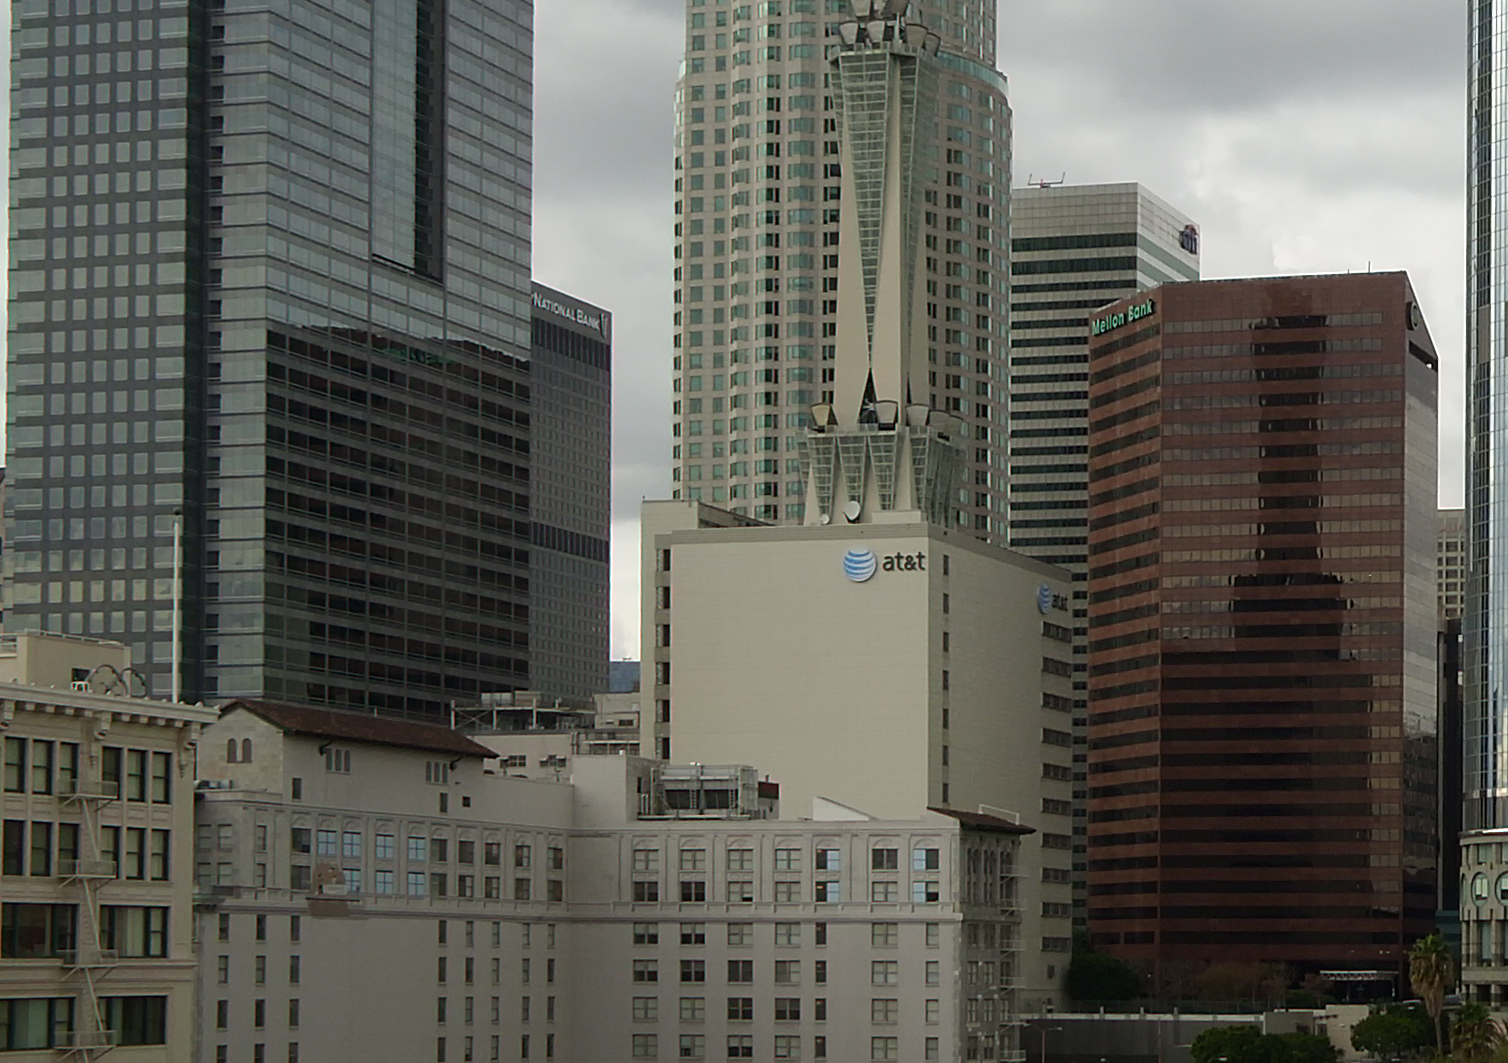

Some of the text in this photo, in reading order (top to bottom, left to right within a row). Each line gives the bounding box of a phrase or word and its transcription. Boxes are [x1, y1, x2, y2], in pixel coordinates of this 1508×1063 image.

[1091, 298, 1155, 336] Mellon Bank
[882, 550, 926, 572] at&t
